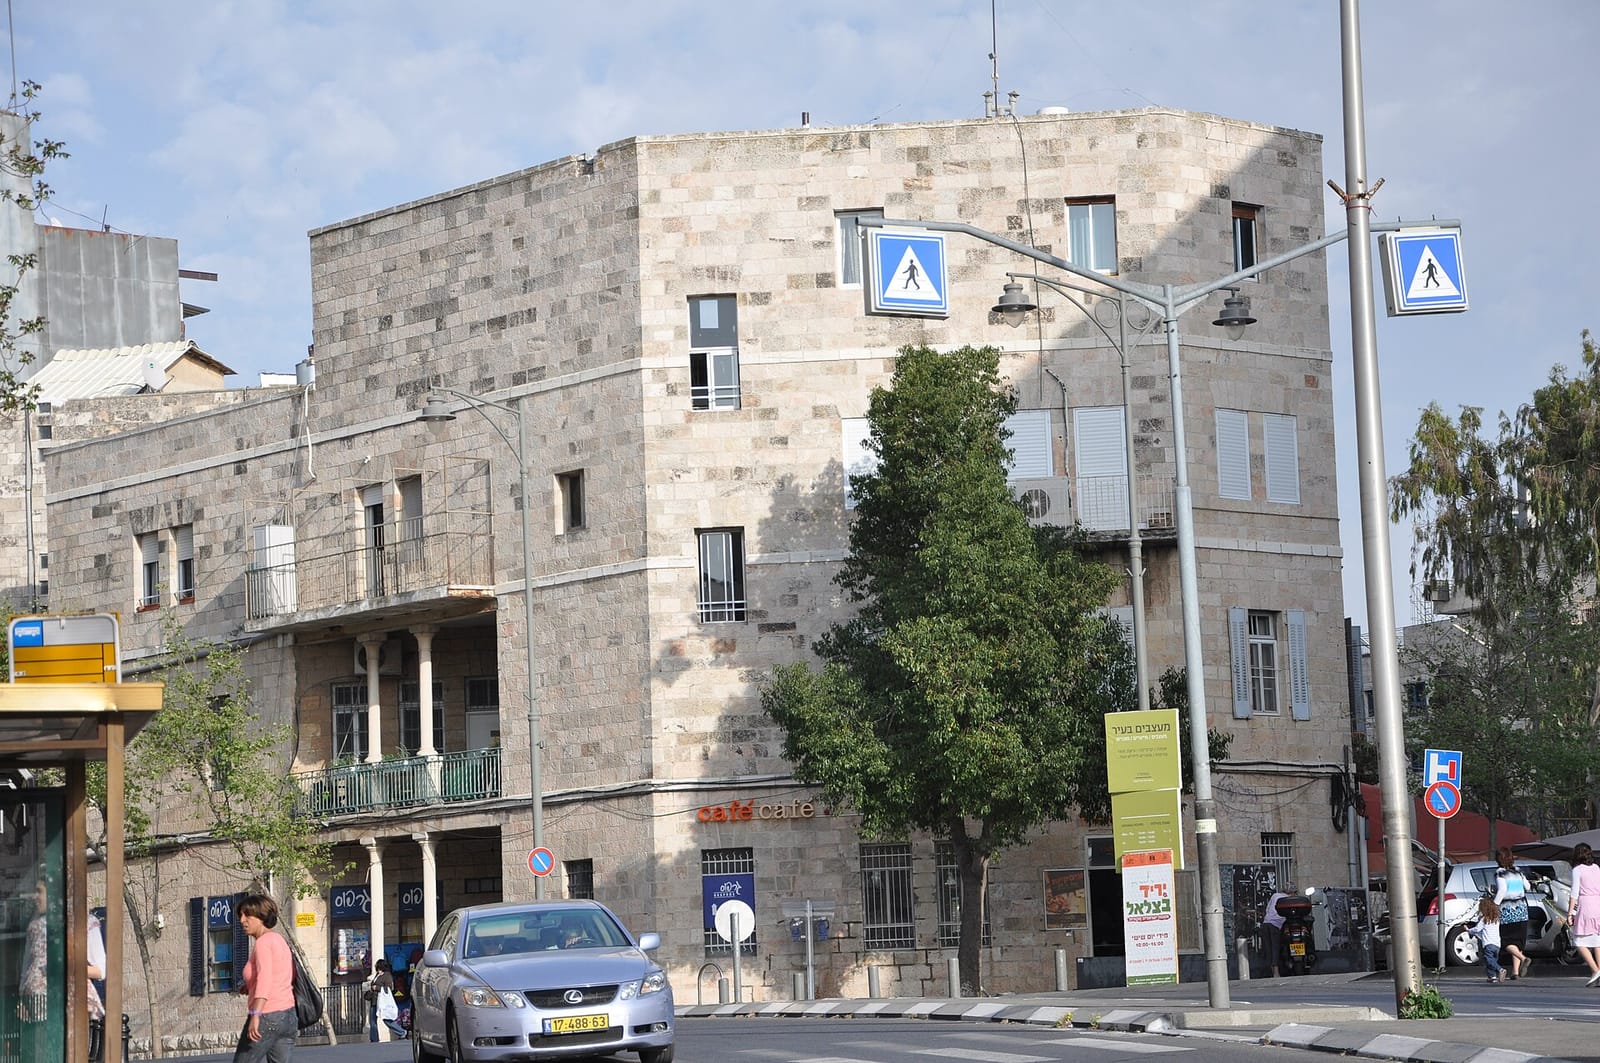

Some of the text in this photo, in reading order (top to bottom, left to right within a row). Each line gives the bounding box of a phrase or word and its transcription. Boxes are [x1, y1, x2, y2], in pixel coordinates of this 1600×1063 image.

[1112, 723, 1171, 735] מעצבים בעיר
[698, 798, 815, 822] café café
[1139, 883, 1167, 898] יריד
[1126, 898, 1171, 915] בצלאל
